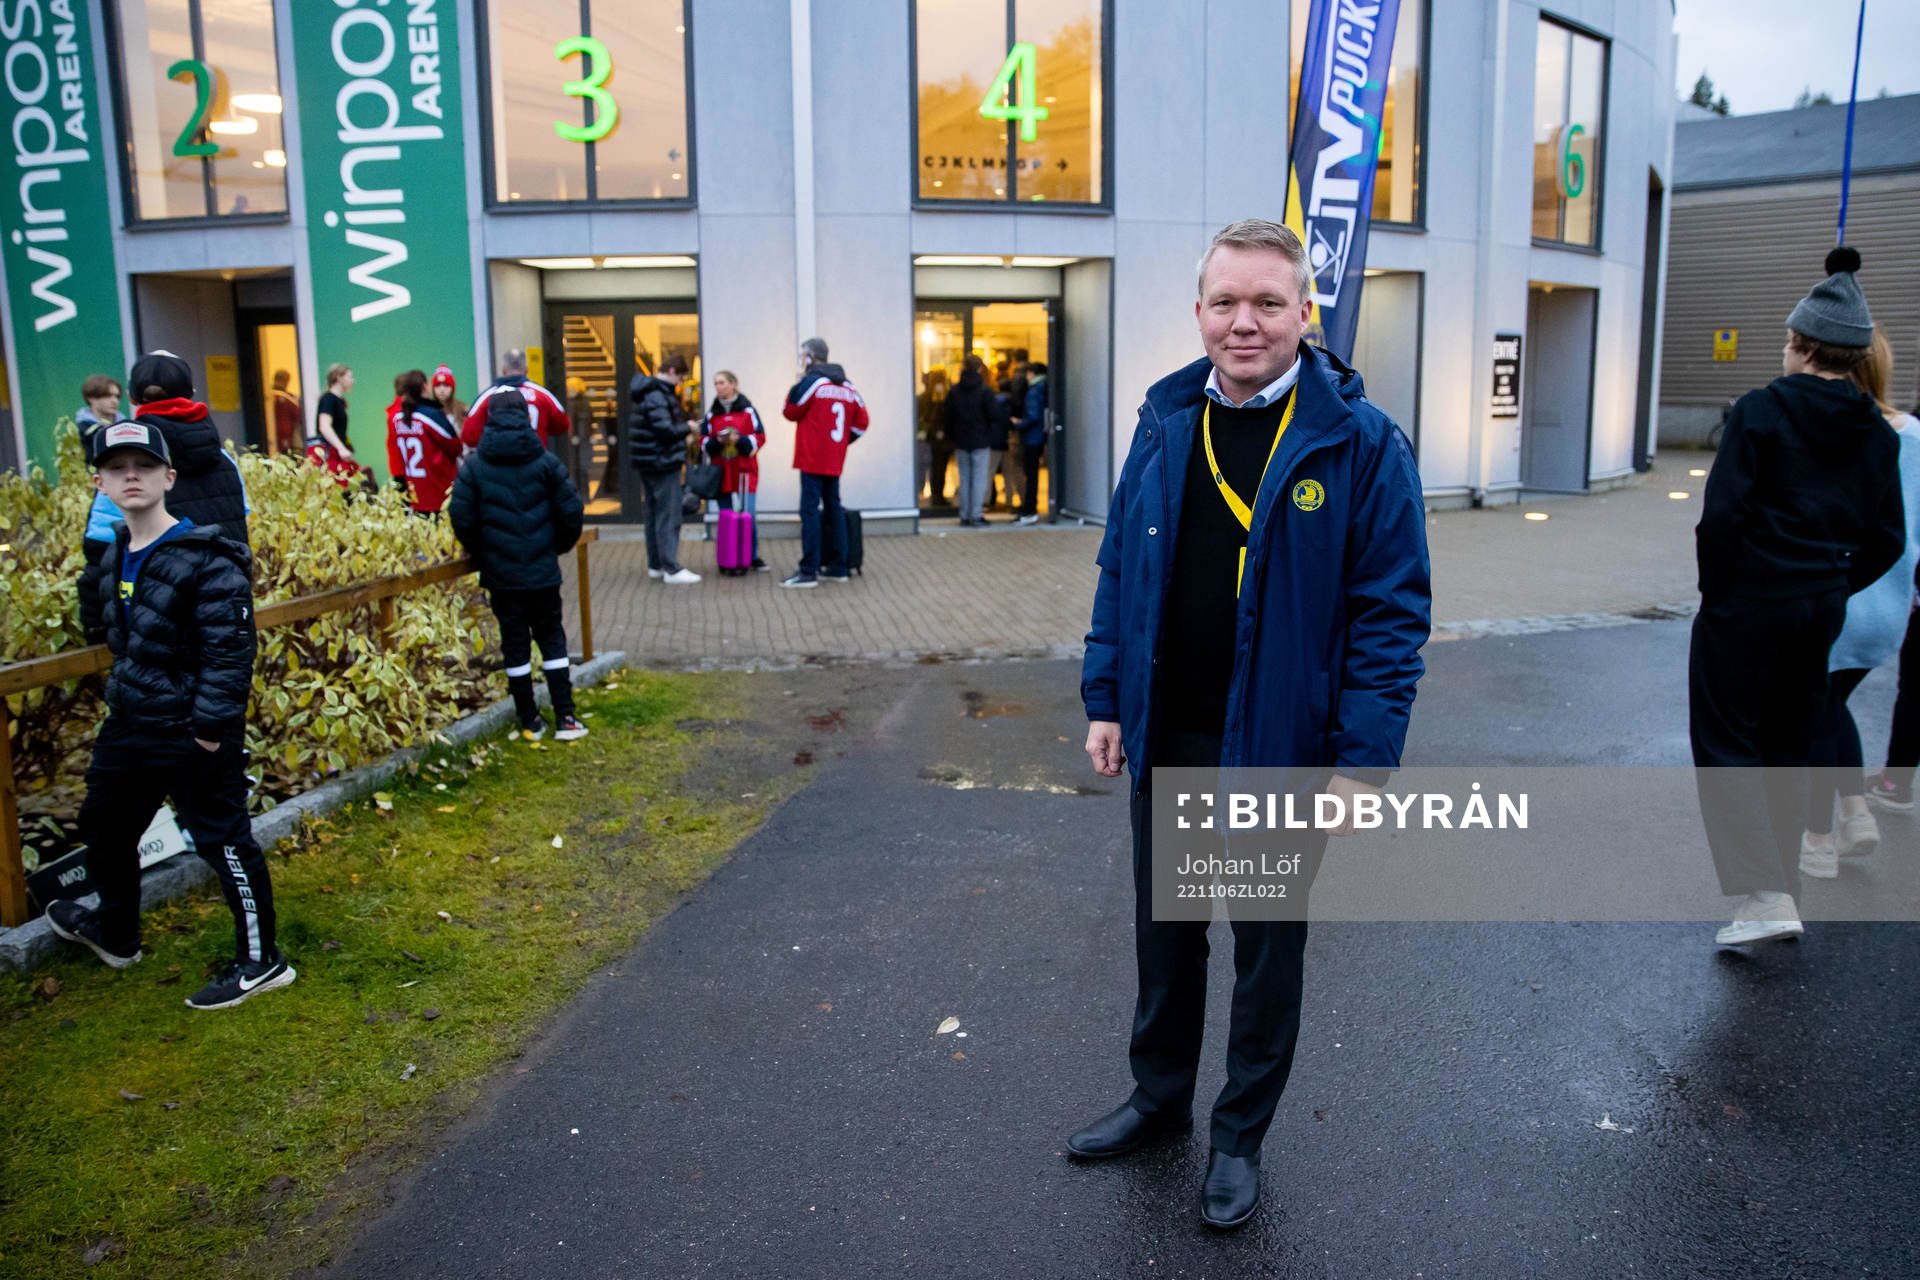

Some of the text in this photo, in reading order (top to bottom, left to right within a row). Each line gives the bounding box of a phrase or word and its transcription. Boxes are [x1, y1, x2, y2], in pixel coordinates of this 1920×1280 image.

[554, 36, 617, 143] 3
[980, 43, 1049, 142] 4
[1331, 0, 1381, 118] PUCK
[167, 60, 219, 157] 2
[324, 0, 444, 323] winpo
[1563, 124, 1585, 198] 6
[397, 437, 427, 478] 12
[830, 402, 845, 443] 3
